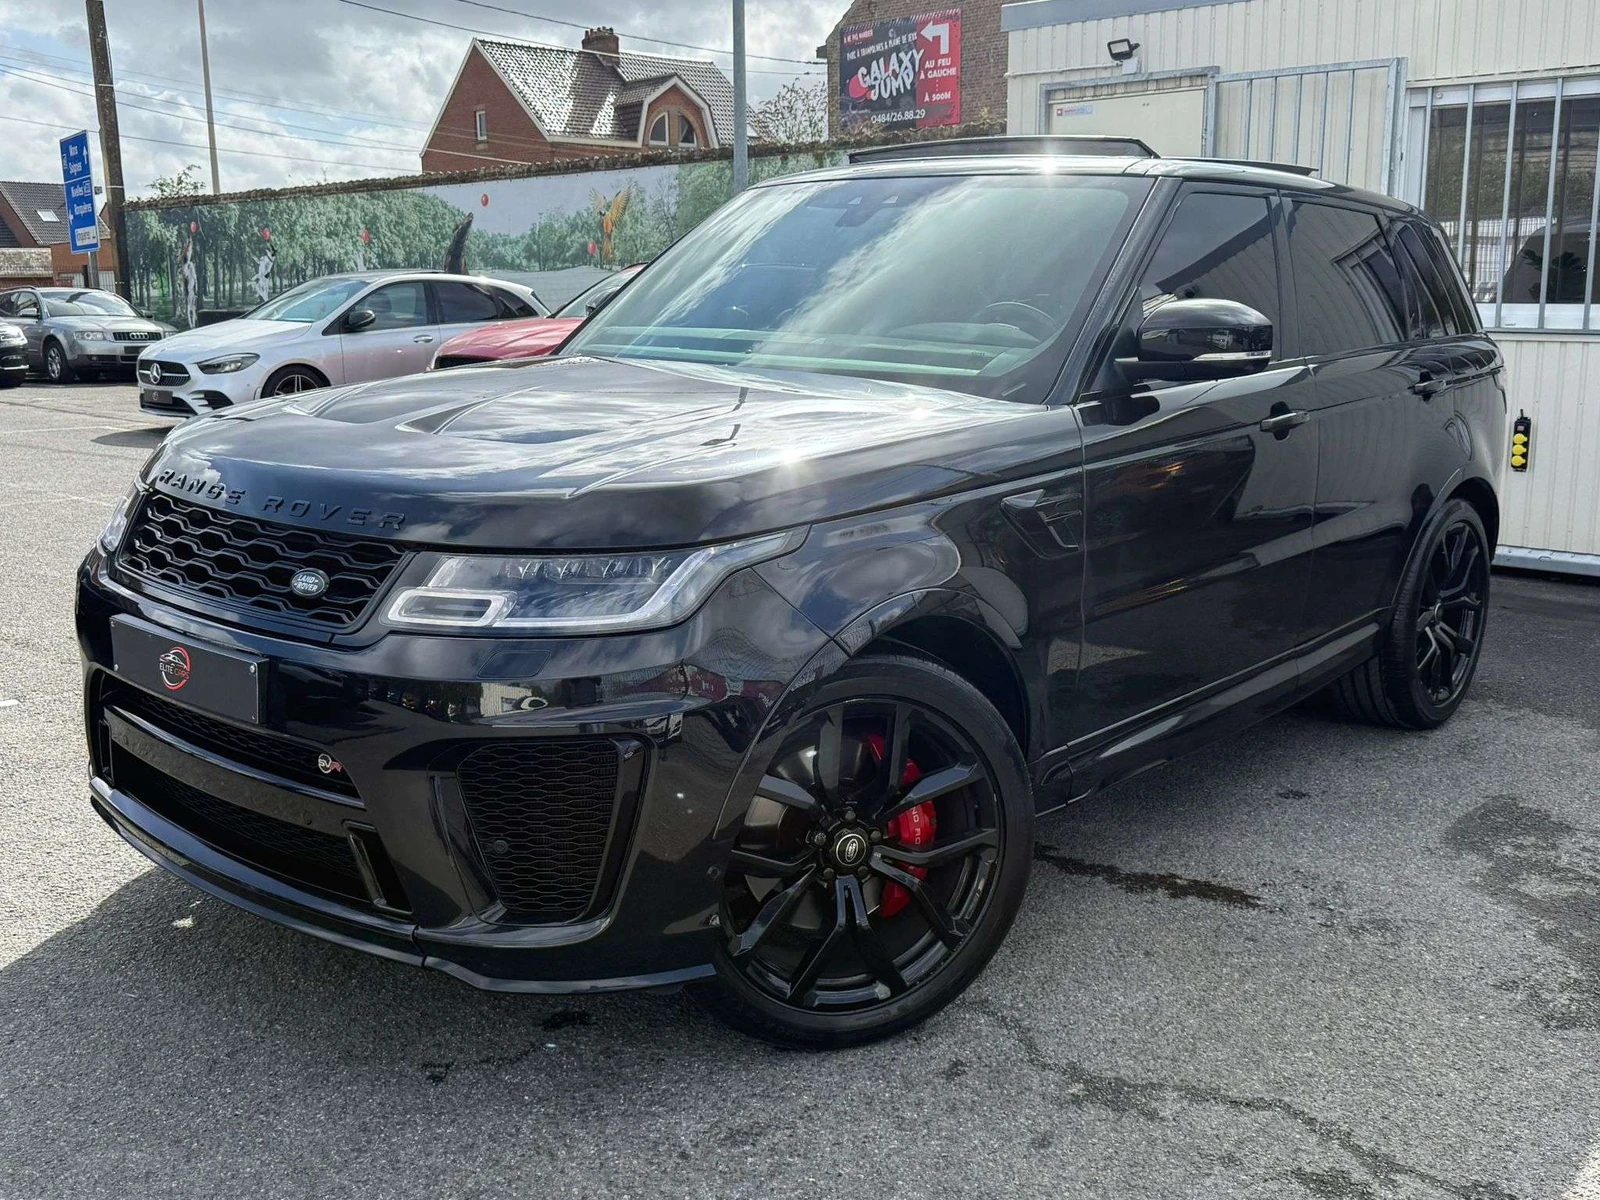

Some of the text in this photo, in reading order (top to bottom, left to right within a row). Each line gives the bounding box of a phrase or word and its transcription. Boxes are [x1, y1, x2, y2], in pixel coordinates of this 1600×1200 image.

[857, 48, 924, 88] GALAXY
[925, 57, 951, 69] AU FEU
[919, 67, 957, 80] À GAUCHE
[870, 67, 915, 101] JUMP
[924, 92, 930, 102] À
[871, 109, 926, 123] 0484/26.88.29
[157, 467, 407, 531] RANGE ROVER
[297, 574, 316, 584] LAND
[296, 581, 318, 592] ROVER
